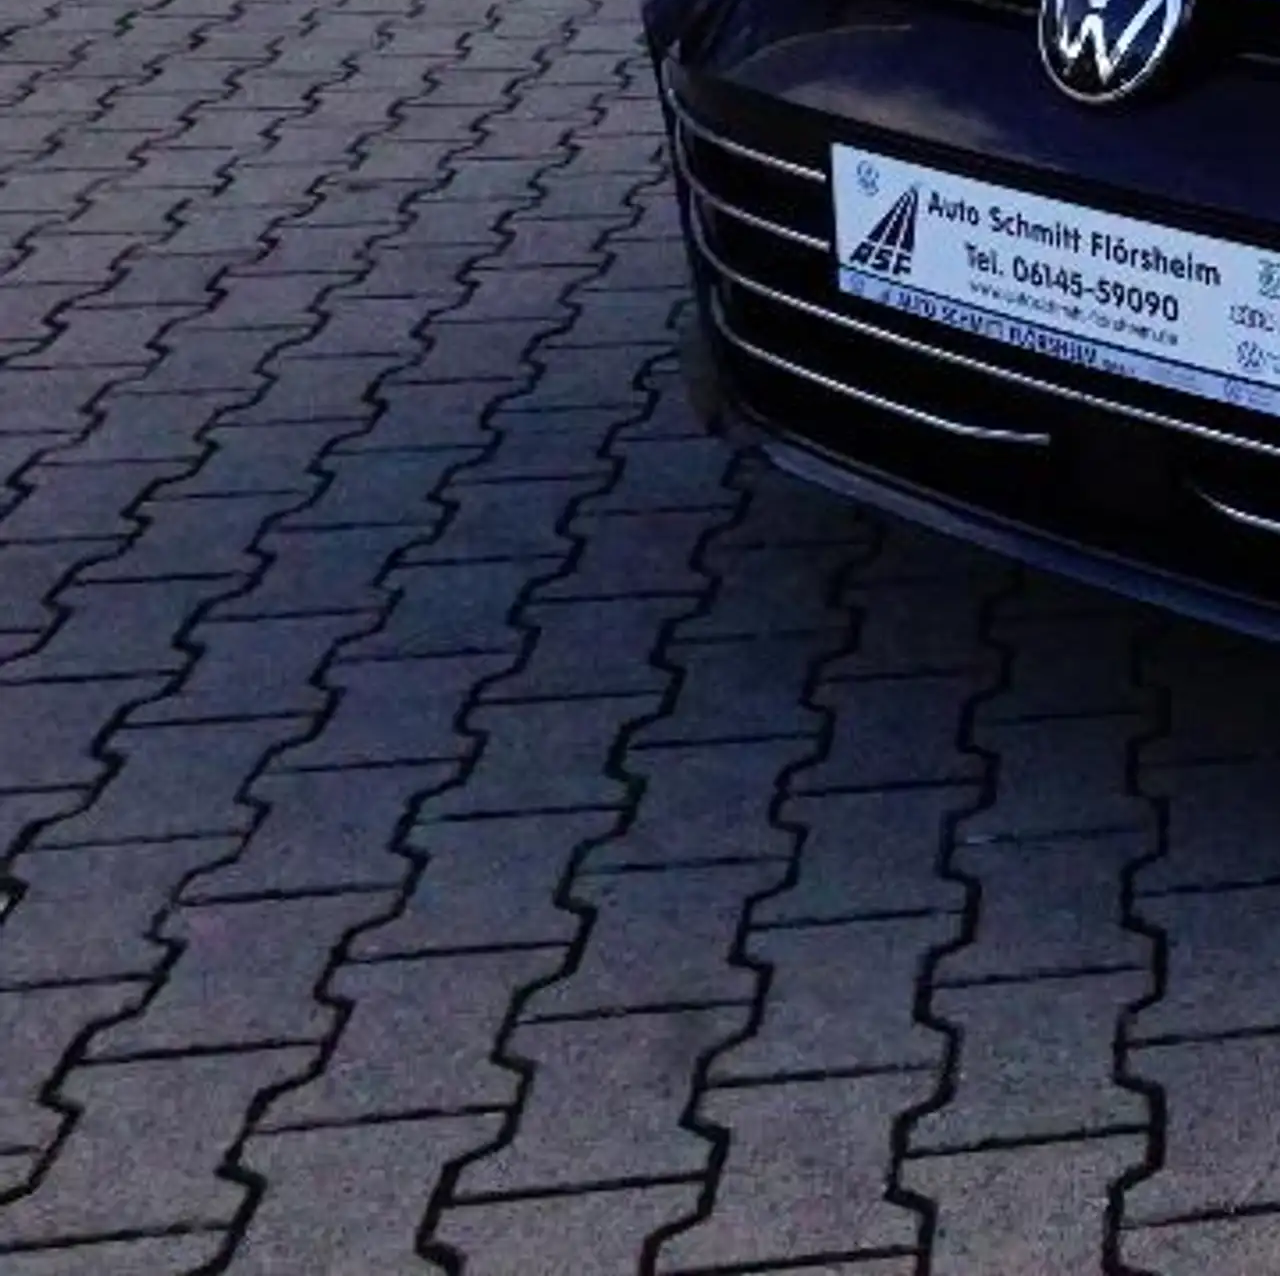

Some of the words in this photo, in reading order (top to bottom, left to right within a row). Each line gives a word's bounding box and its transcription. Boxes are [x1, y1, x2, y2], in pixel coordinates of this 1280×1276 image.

[927, 191, 980, 226] Auto
[988, 205, 1082, 254] Schmitt
[964, 241, 1004, 277] Tel.
[1011, 255, 1180, 322] 06145-59090
